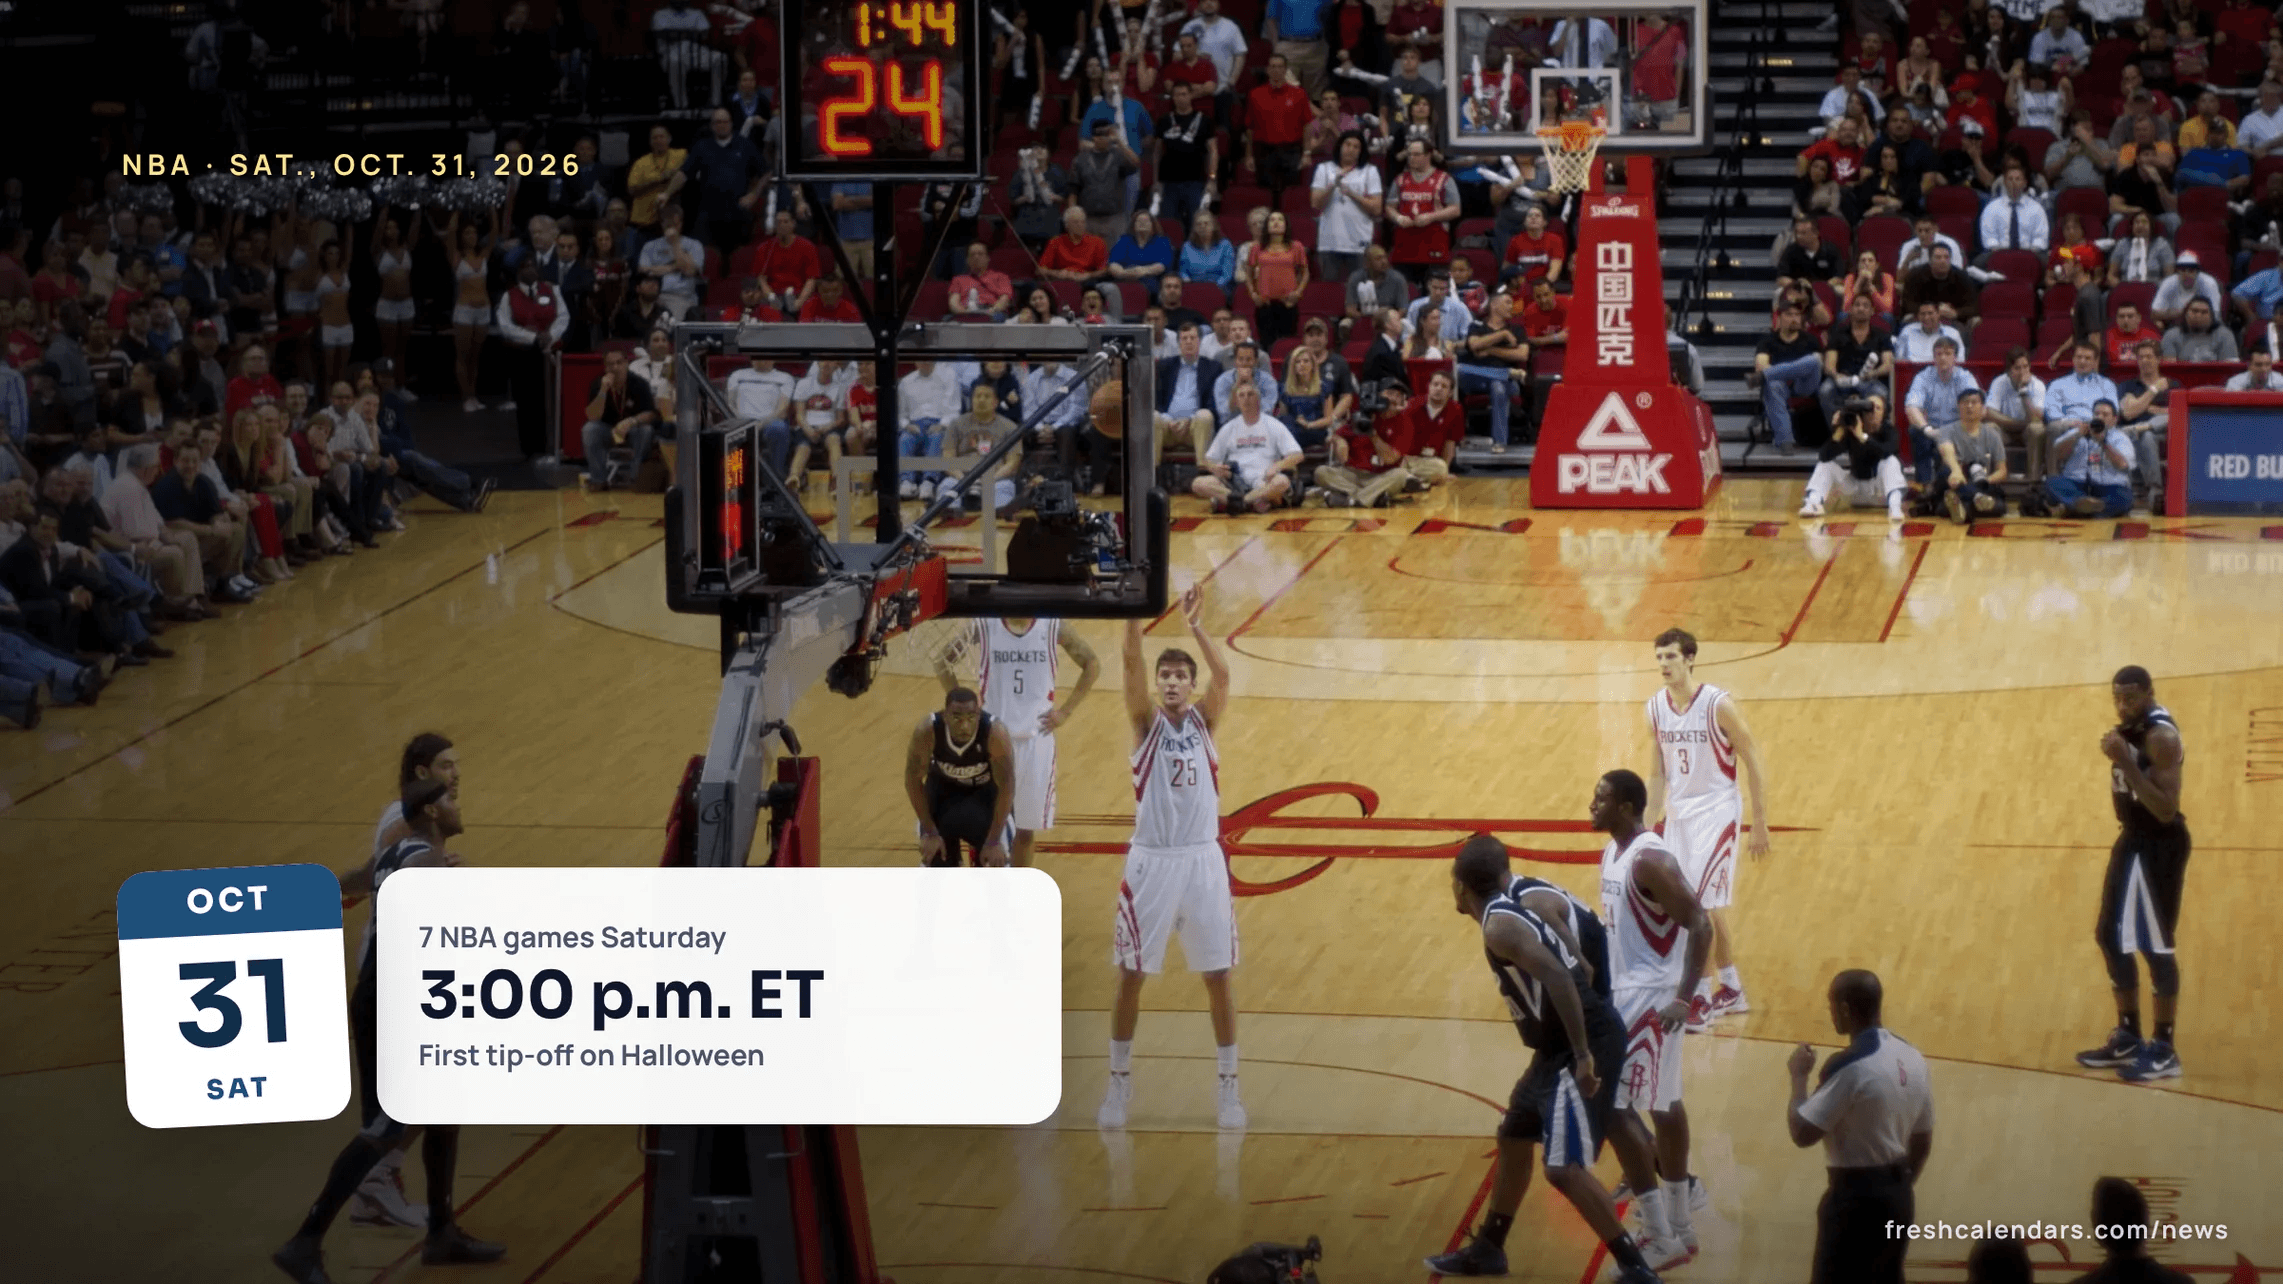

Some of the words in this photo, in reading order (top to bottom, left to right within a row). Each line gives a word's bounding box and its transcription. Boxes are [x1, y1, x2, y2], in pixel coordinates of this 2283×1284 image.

[857, 2, 956, 47] 1:44
[819, 58, 944, 155] 24
[1597, 241, 1634, 366] 中国匹克
[1558, 453, 1673, 493] PEAK
[2208, 454, 2251, 479] RED
[993, 650, 1047, 663] ROCKETS
[1013, 669, 1024, 694] 5
[1660, 730, 1707, 743] ROCKETS
[1170, 758, 1197, 787] 25
[1678, 748, 1690, 774] 3
